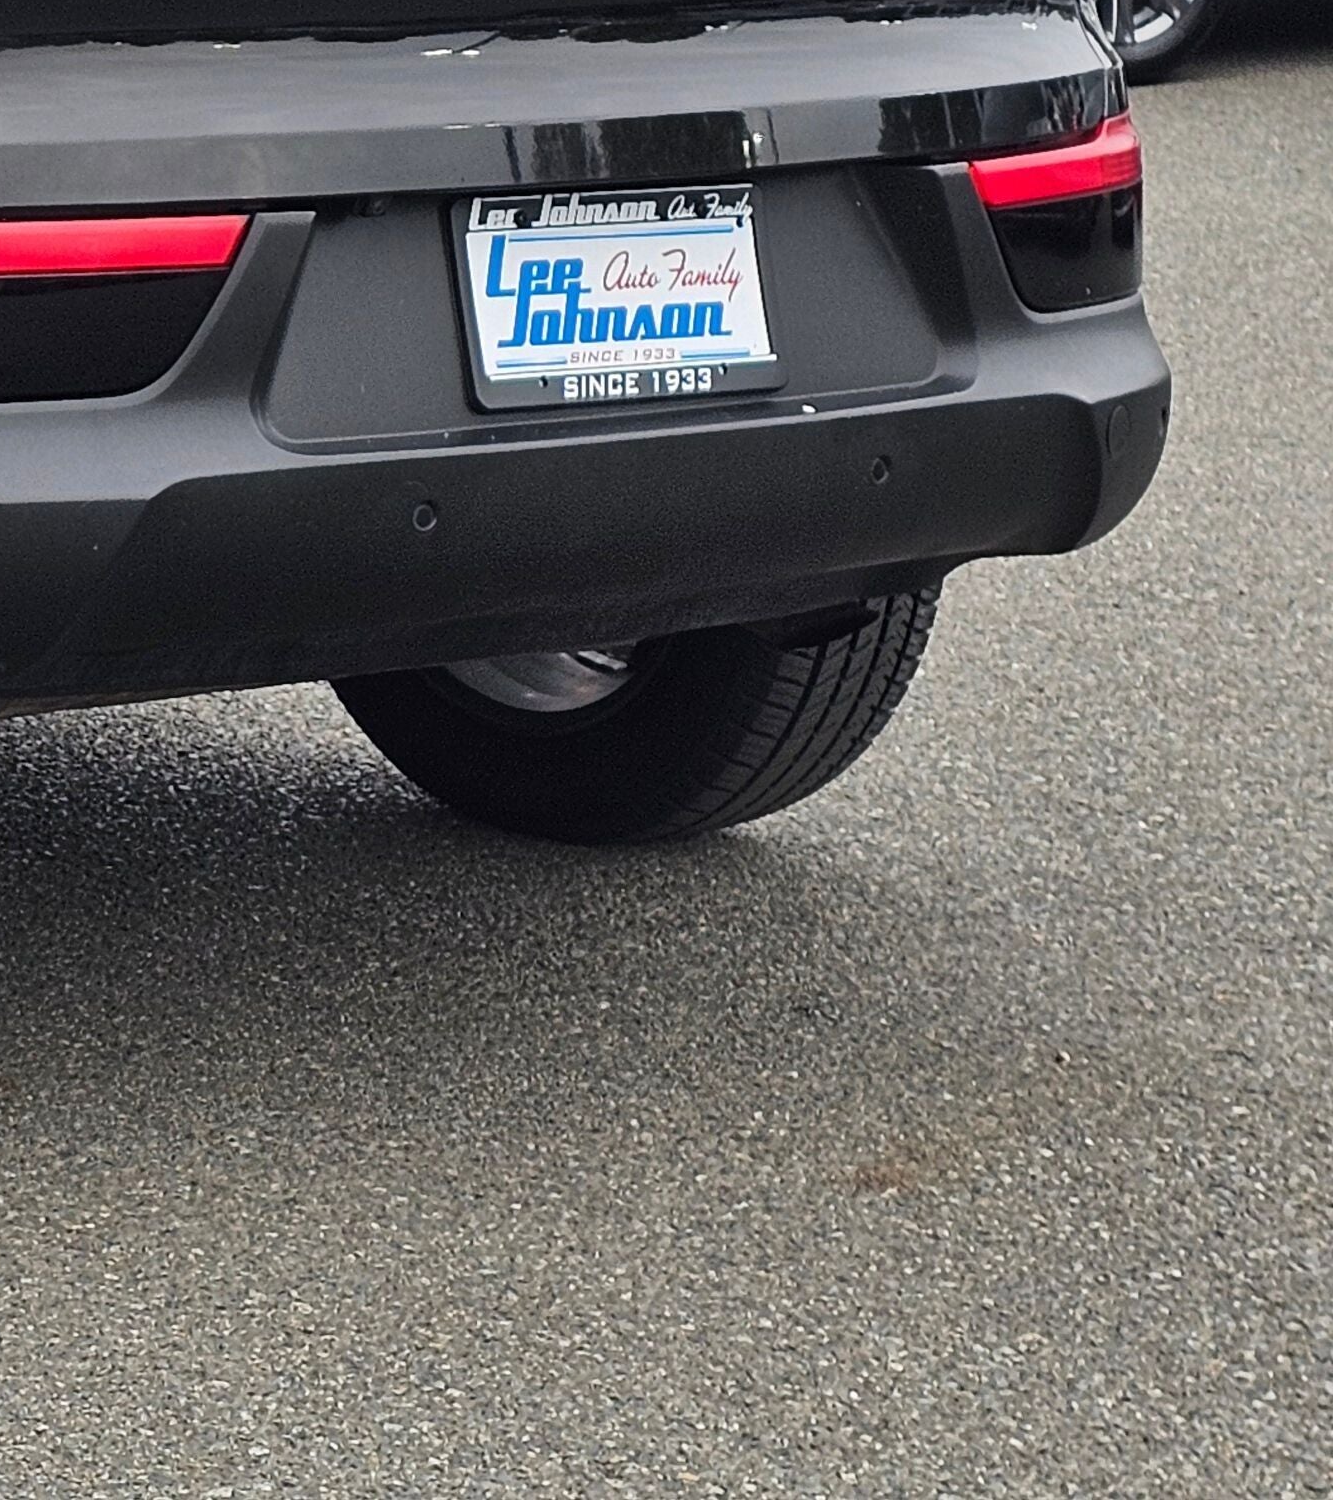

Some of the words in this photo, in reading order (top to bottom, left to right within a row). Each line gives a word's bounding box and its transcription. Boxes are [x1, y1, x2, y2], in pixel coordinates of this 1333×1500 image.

[530, 192, 661, 228] Johnson
[667, 194, 698, 220] Aut
[485, 234, 591, 298] Lee
[603, 251, 661, 293] Auto
[662, 246, 743, 302] Family
[496, 280, 733, 348] Johnson
[569, 349, 624, 364] SINCE
[633, 347, 675, 361] 1933
[563, 371, 640, 400] SINCE
[652, 366, 712, 394] 1933
